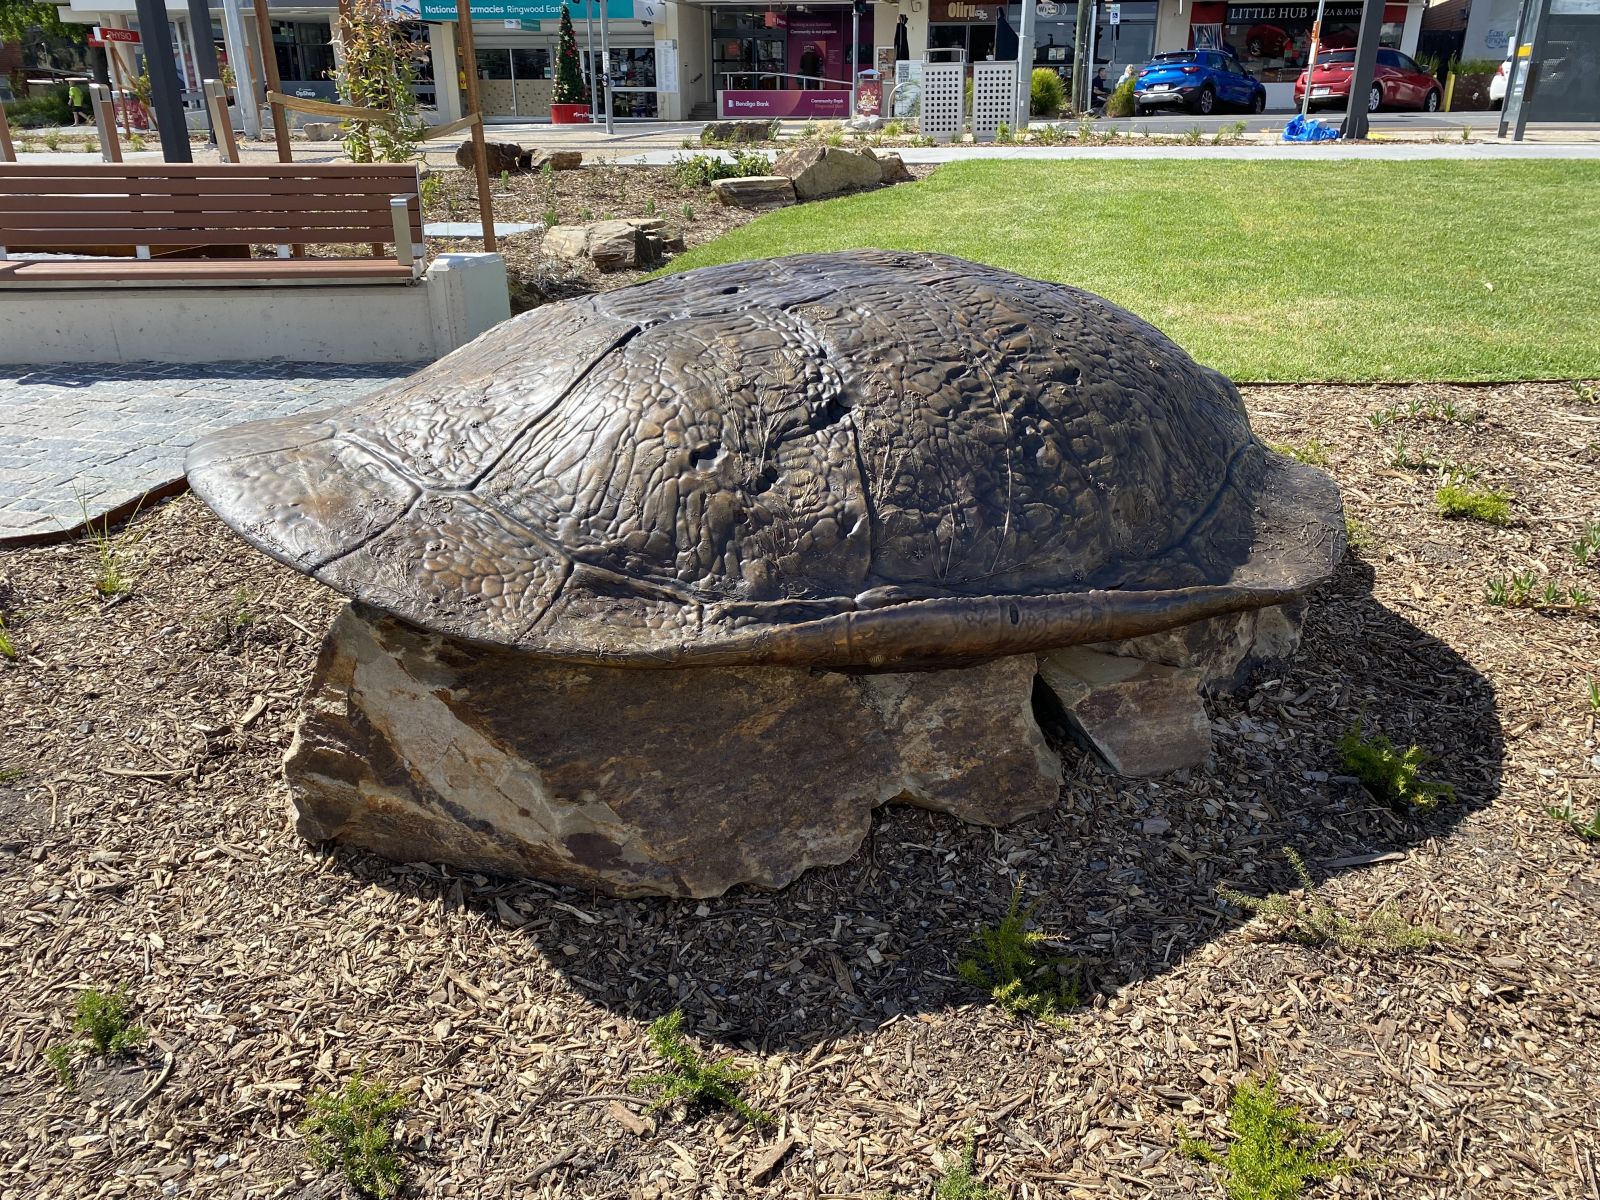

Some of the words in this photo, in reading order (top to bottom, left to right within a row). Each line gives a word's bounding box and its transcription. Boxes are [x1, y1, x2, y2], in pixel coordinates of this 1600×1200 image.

[424, 4, 458, 15] National
[469, 4, 505, 15] armacies
[506, 5, 545, 16] Ringwood
[545, 4, 562, 14] East
[1230, 7, 1276, 19] LITTLE
[1278, 7, 1308, 19] HUB
[1311, 8, 1335, 17] PZA
[1336, 8, 1343, 16] &
[1344, 8, 1363, 16] PAST
[106, 30, 132, 41] PHYSIO
[296, 90, 316, 98] OpShop
[735, 100, 756, 108] Bendigo
